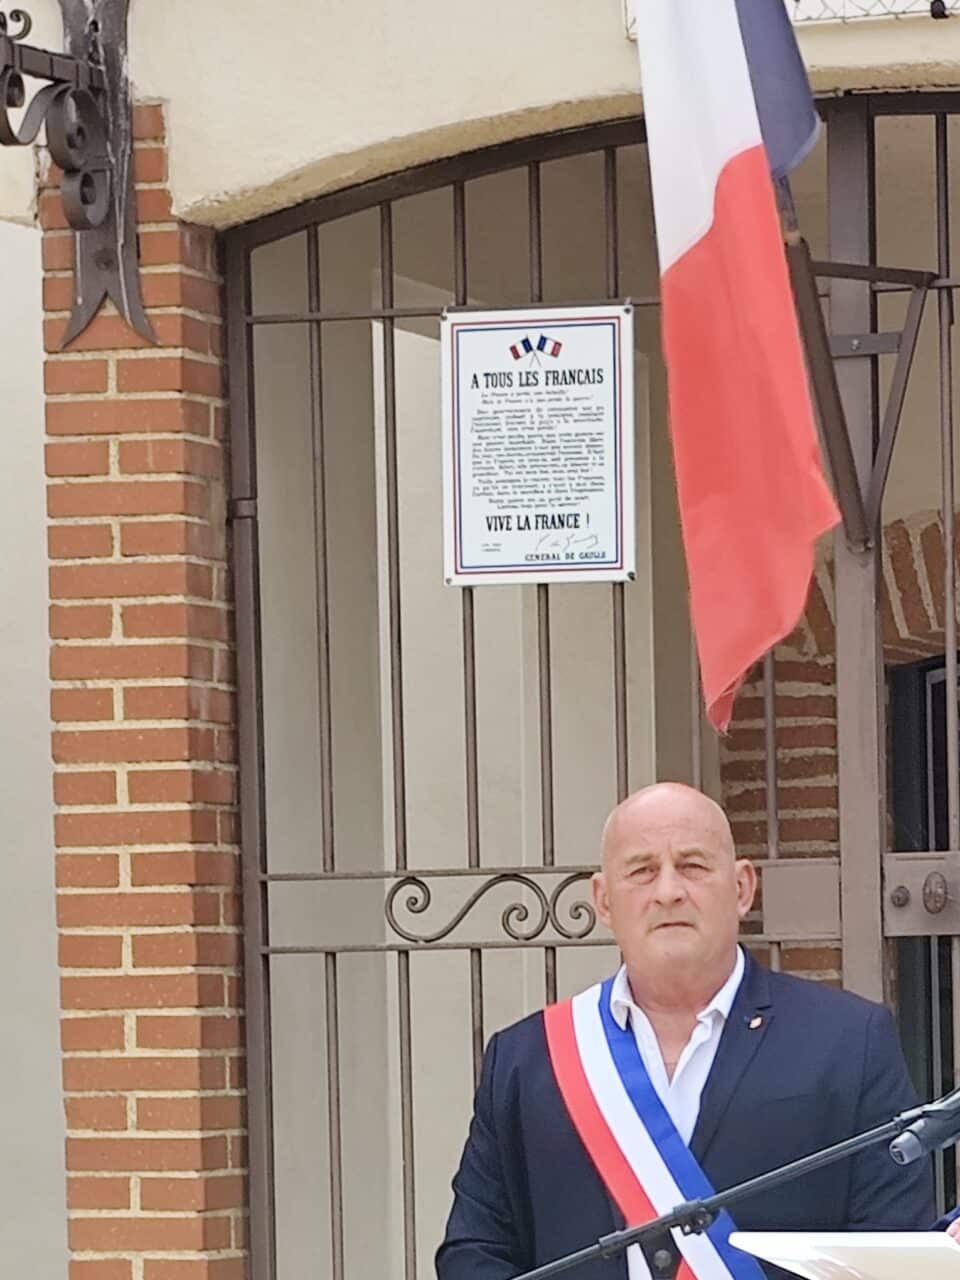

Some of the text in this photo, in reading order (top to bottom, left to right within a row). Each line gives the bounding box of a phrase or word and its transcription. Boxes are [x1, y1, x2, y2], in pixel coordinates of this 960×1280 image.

[471, 373, 479, 389] A
[483, 372, 513, 389] TOUS
[519, 371, 539, 387] LES
[486, 515, 512, 532] VIVE
[517, 515, 531, 530] LA
[535, 513, 580, 530] FRANCE
[565, 552, 575, 560] DE
